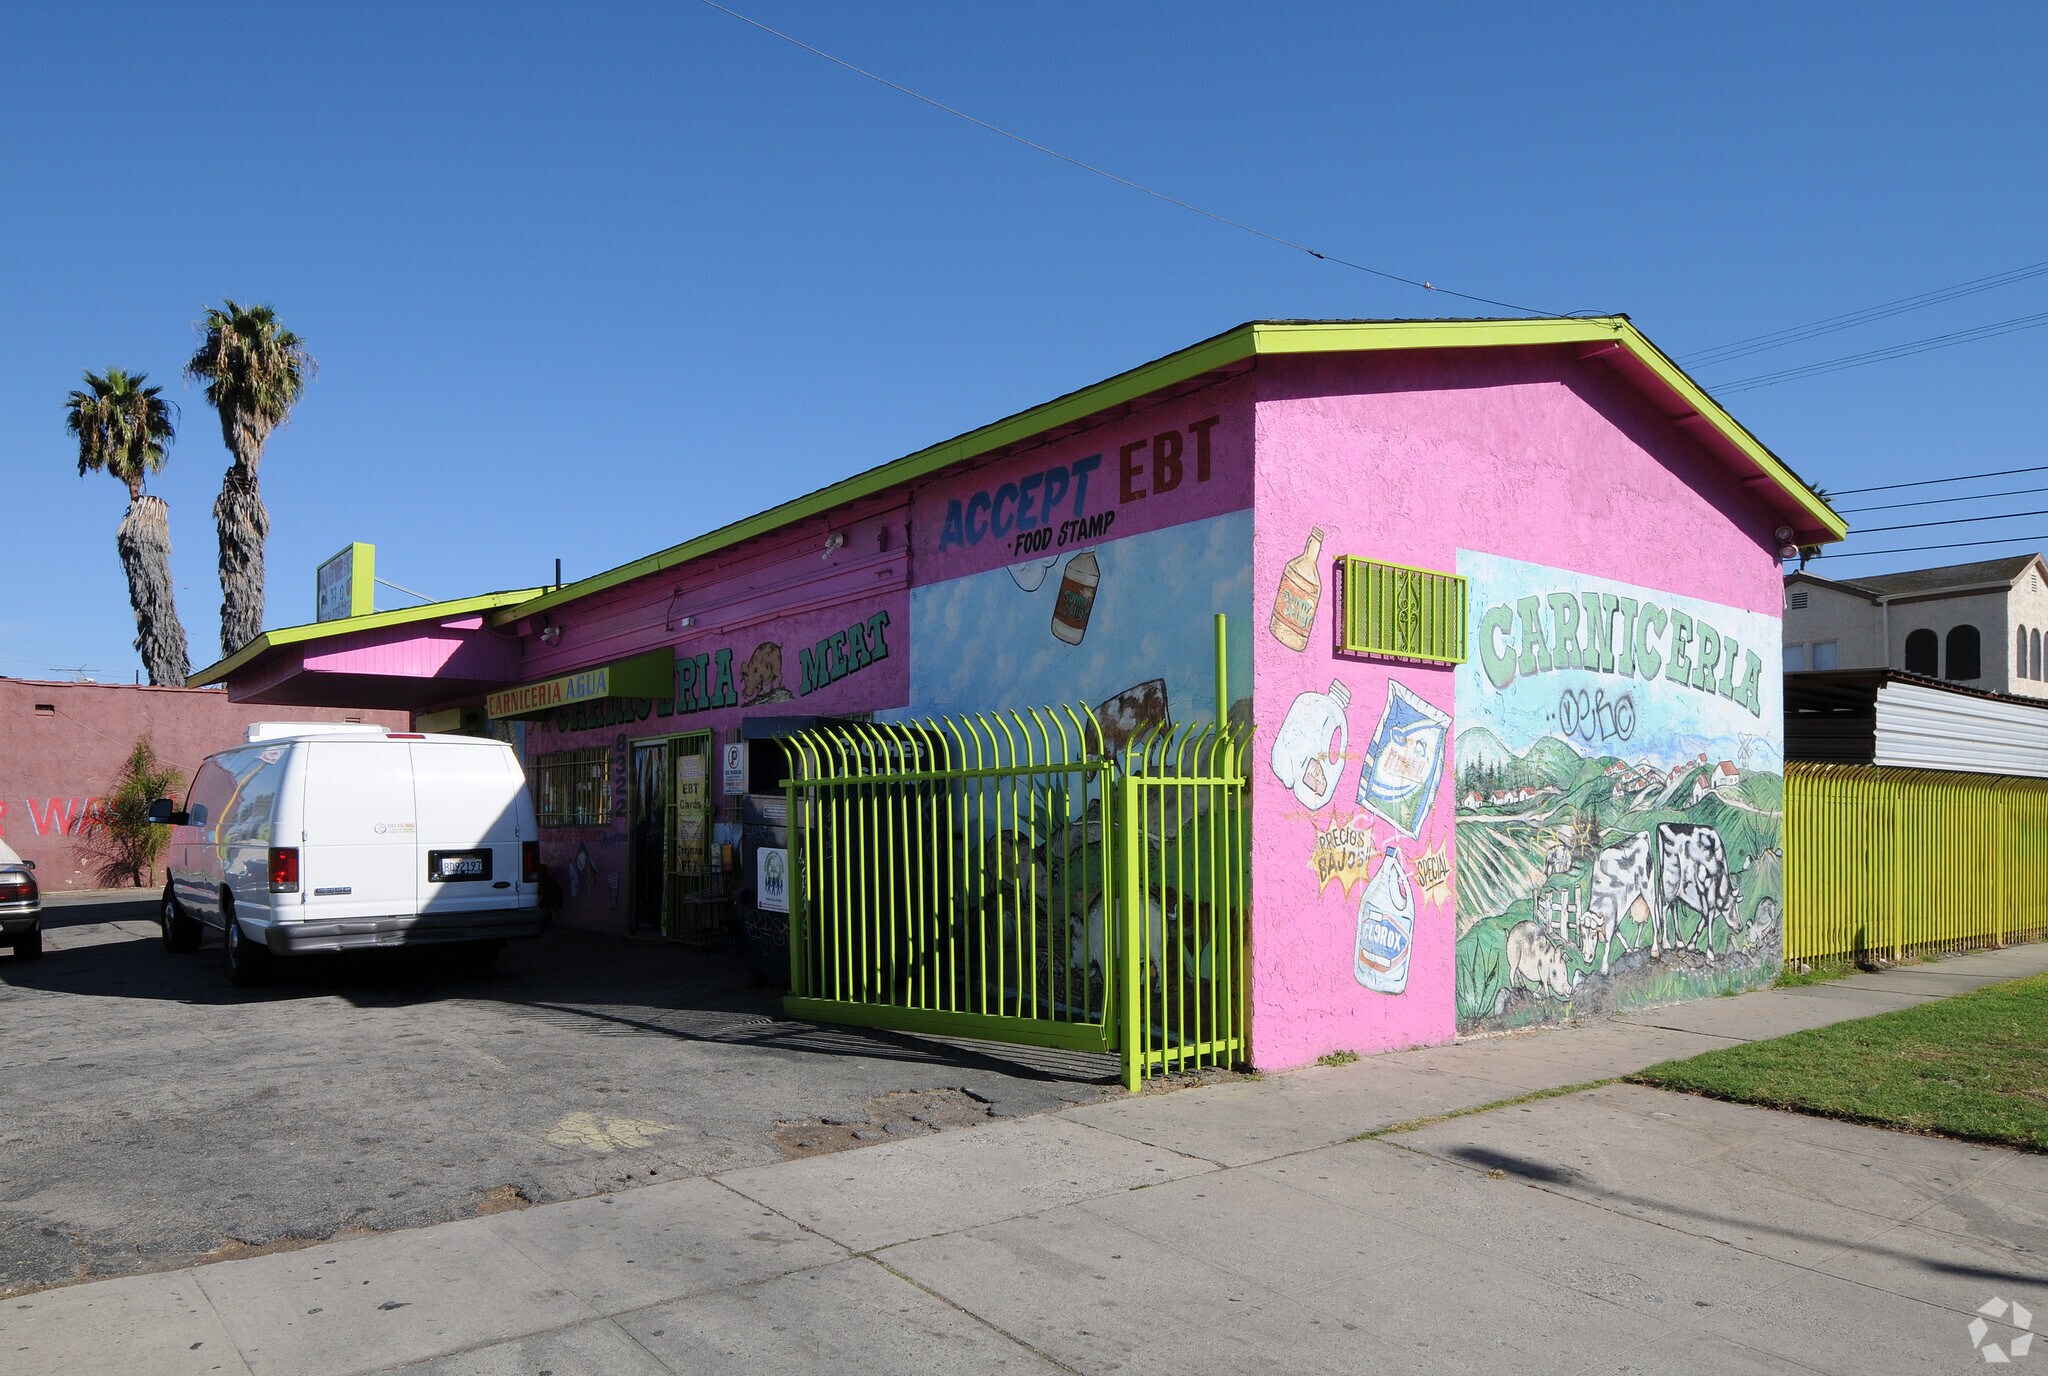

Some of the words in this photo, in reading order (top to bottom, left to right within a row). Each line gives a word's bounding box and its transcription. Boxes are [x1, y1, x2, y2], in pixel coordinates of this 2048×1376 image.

[939, 453, 1103, 553] ACCEPT
[1118, 415, 1220, 505] EBT
[1014, 527, 1053, 557] FOOD
[1057, 510, 1116, 548] STAMP
[799, 610, 891, 697] MEAT
[1478, 591, 1763, 719] CARNICERIA
[488, 681, 562, 716] CARNICERIA
[565, 670, 607, 700] AGUA
[679, 799, 702, 810] Cards
[682, 782, 700, 794] EBT
[1319, 827, 1365, 851] PRECIOS
[1417, 853, 1450, 887] SPECIAL
